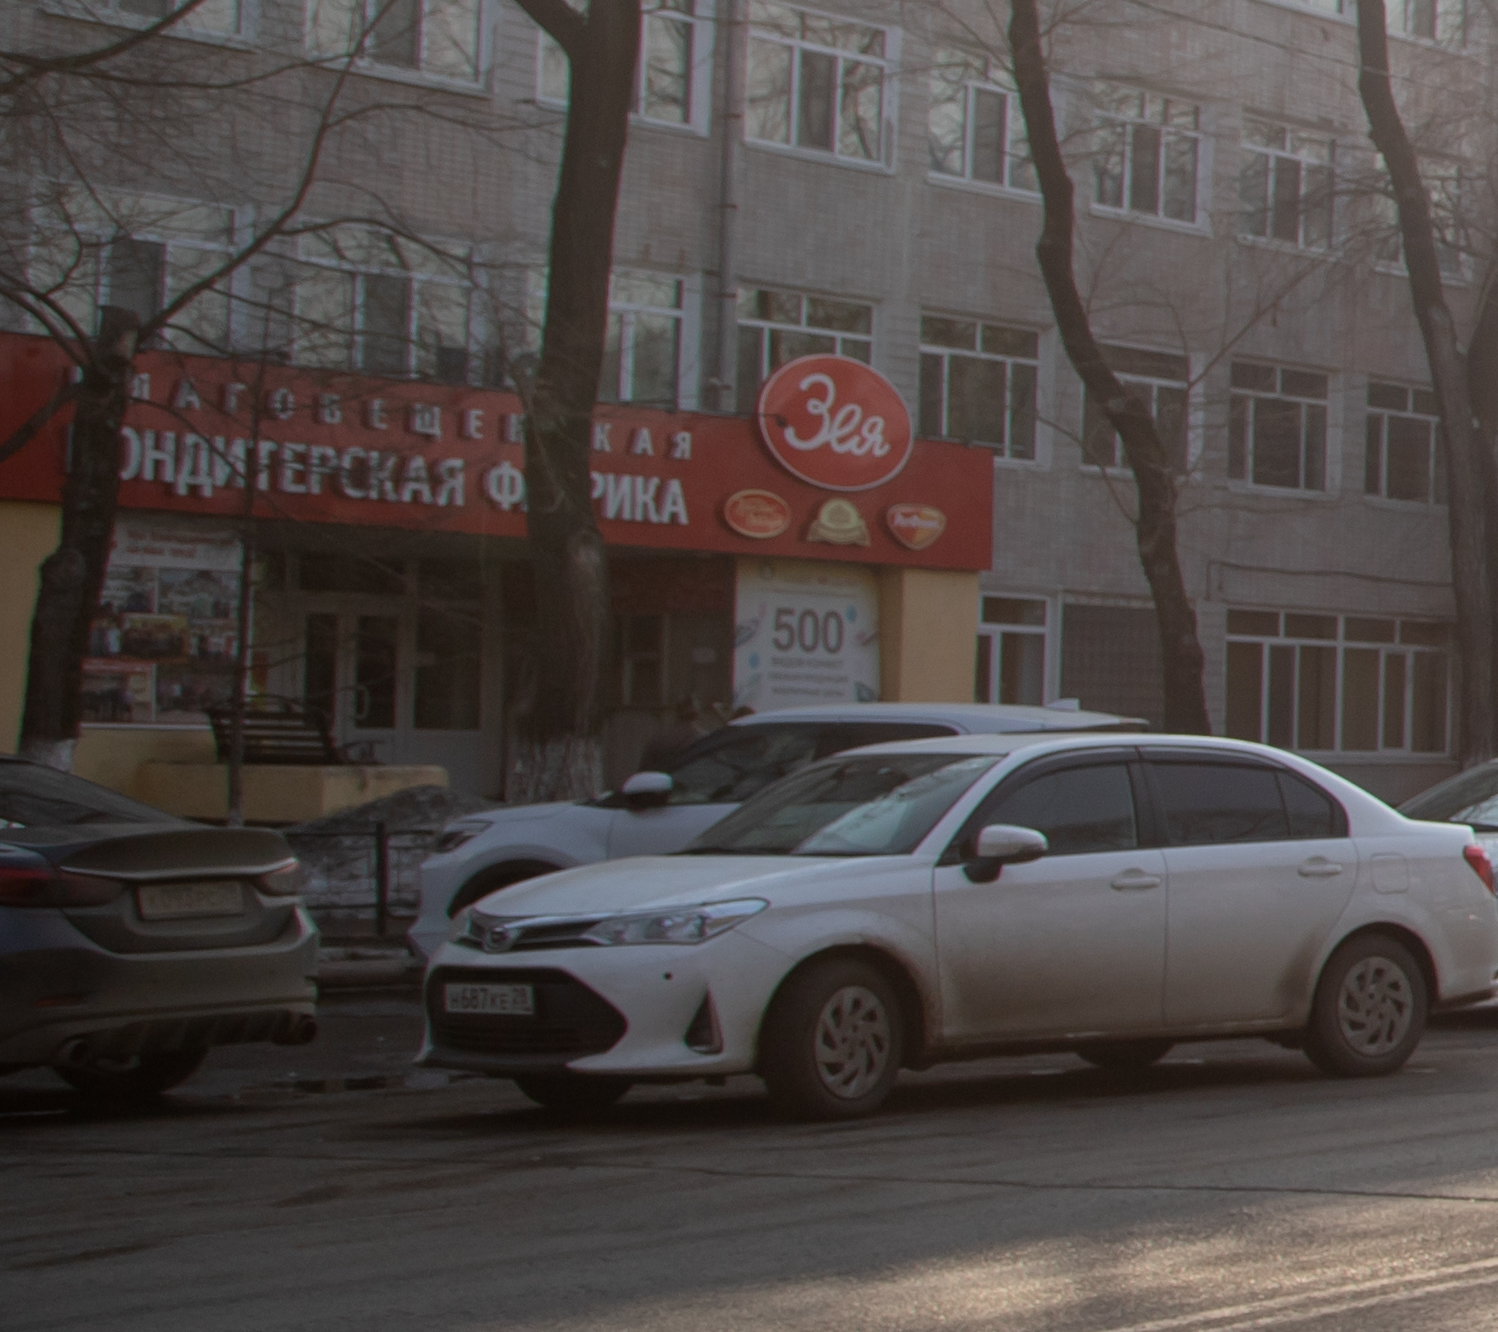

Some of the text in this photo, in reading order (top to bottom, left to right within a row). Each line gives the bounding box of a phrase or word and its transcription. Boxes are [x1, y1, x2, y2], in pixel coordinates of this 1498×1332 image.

[69, 365, 692, 461] ЛАГОВЕЩЕНКАЯ
[784, 373, 891, 459] Зея
[67, 422, 467, 507] ОНДИТЕРСКАЯ
[484, 461, 690, 525] ФРИКА
[772, 606, 845, 654] 500
